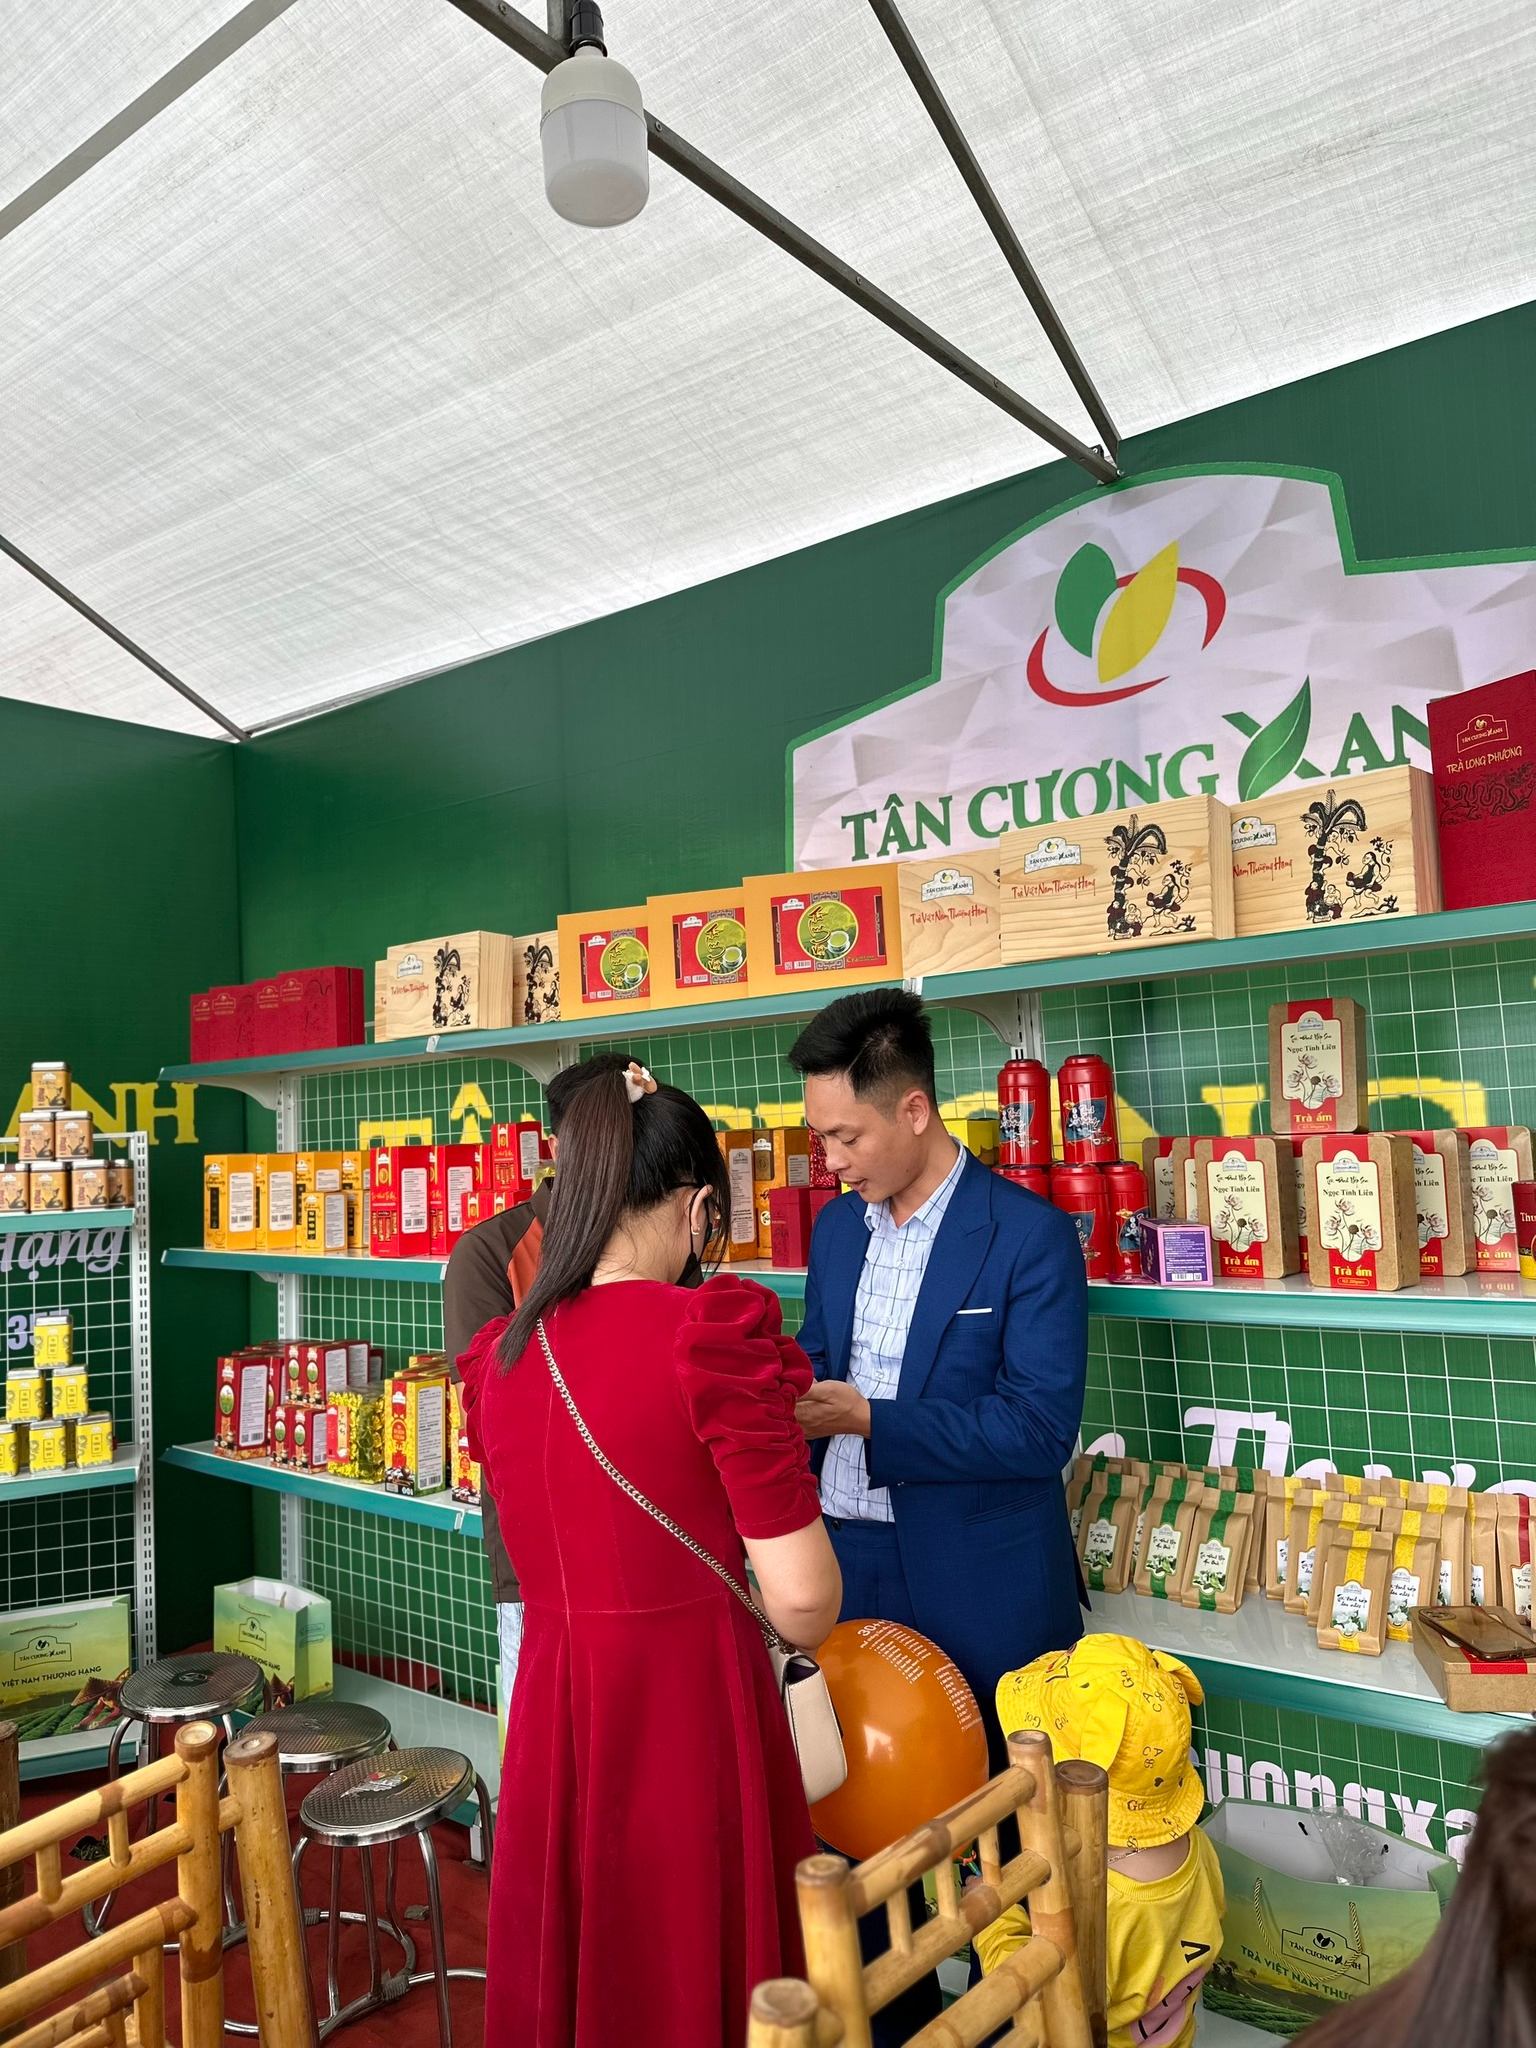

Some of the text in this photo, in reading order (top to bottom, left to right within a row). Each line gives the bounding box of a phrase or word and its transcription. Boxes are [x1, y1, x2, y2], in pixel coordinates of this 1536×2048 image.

[1446, 746, 1522, 774] TRÀ LONG PHƯỢNG
[841, 675, 1433, 862] TÂN CƯƠNG XAN
[1287, 1046, 1303, 1054] Ngọc
[1294, 1111, 1332, 1122] Trà ấm
[1497, 1174, 1513, 1182] Liên
[1213, 1186, 1228, 1194] Ngọc
[1323, 1189, 1339, 1198] Ngọc
[1421, 1252, 1438, 1263] ấm
[1494, 1248, 1511, 1259] ấm
[1223, 1254, 1259, 1266] Trà ấm
[1332, 1264, 1372, 1277] Trà ấm
[2, 1665, 102, 1688] VIỆT NAM THƯỢNG HẠNG
[1289, 1940, 1304, 1952] TÂN
[1305, 1949, 1334, 1963] CƯƠNG
[1240, 1944, 1354, 2000] TRÀ VIỆT NAM THƯ
